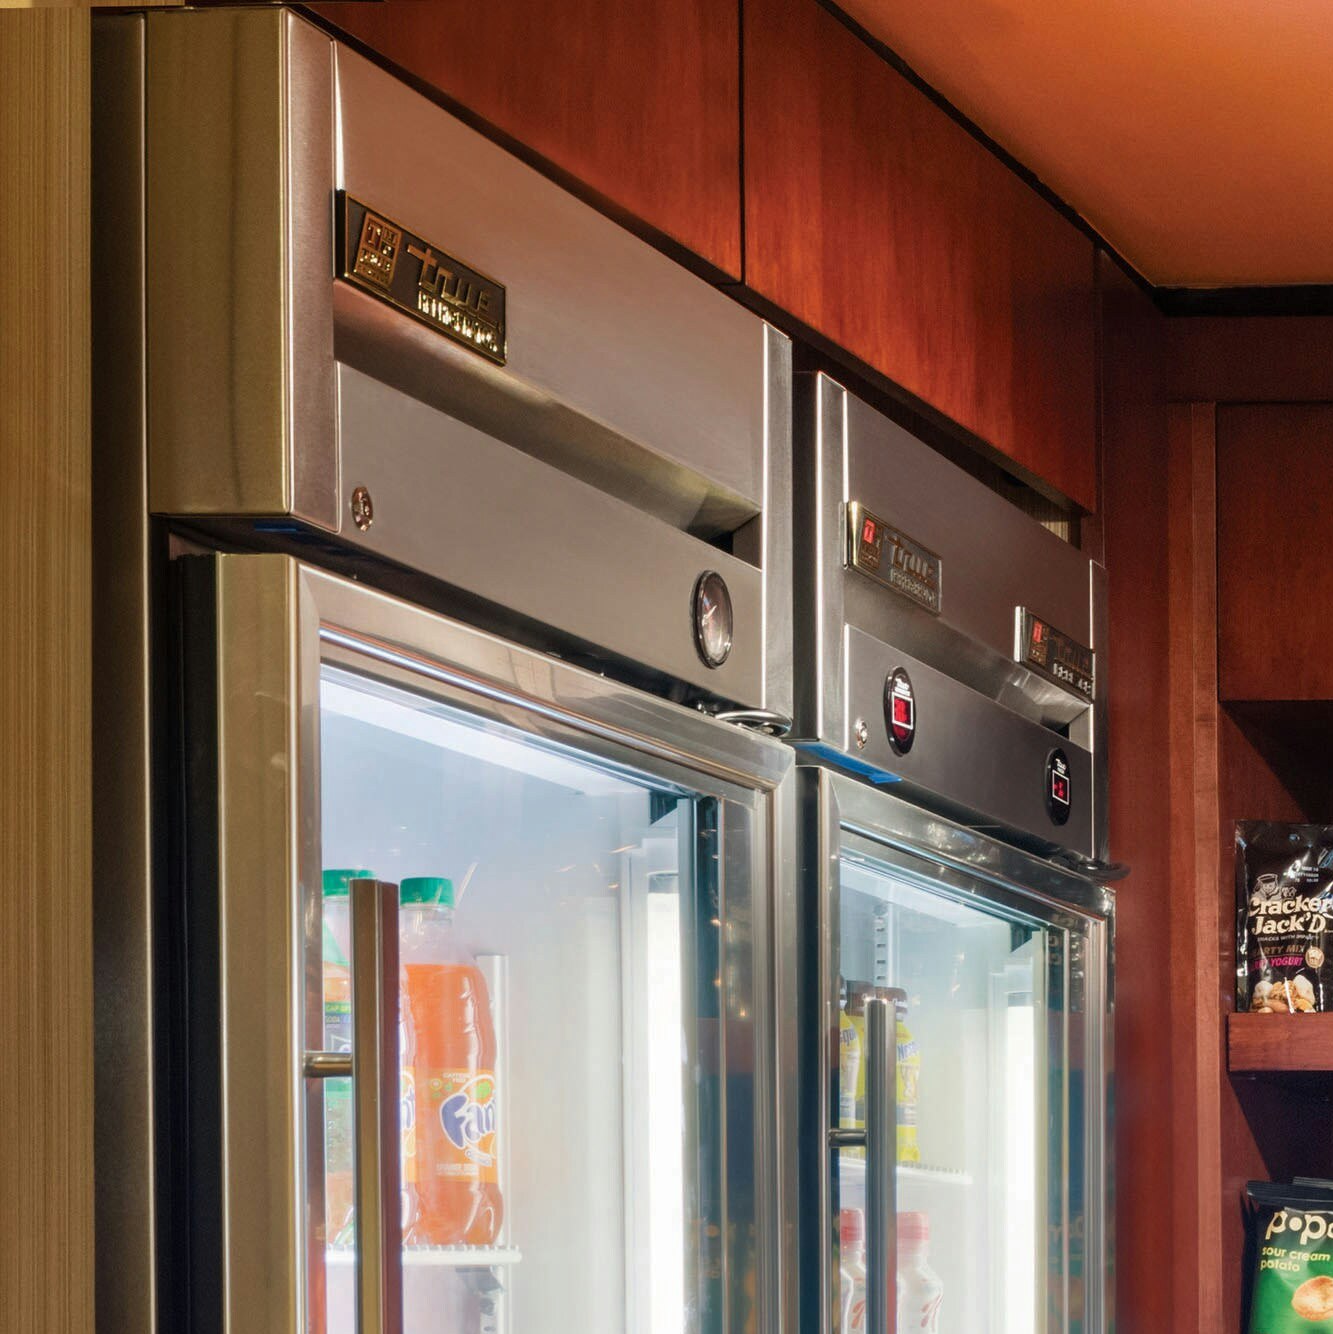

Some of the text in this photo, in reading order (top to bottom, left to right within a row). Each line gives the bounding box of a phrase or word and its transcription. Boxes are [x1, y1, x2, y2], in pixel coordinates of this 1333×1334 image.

[1262, 1247, 1330, 1261] sour cream
[1261, 1260, 1300, 1272] potato
